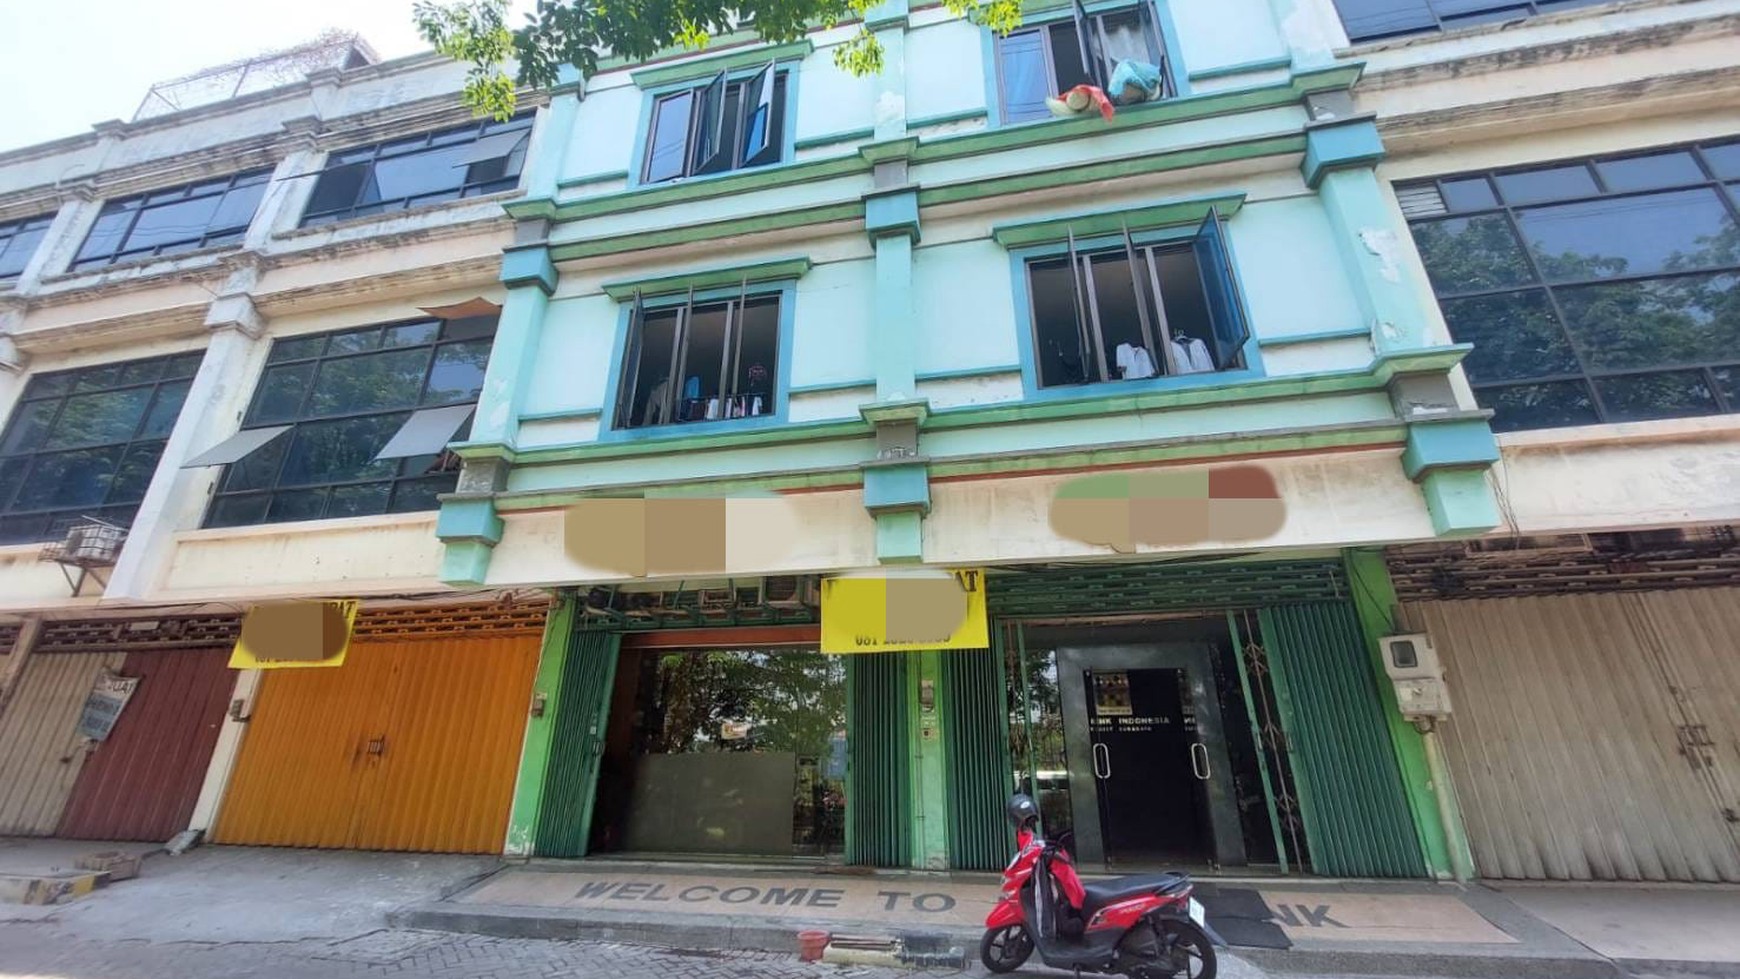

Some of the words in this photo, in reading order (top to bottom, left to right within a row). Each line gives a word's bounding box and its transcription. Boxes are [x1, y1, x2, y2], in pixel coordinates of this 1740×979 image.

[1118, 717, 1170, 725] INDONESIA
[574, 881, 846, 908] WELCOME
[877, 891, 956, 912] TO
